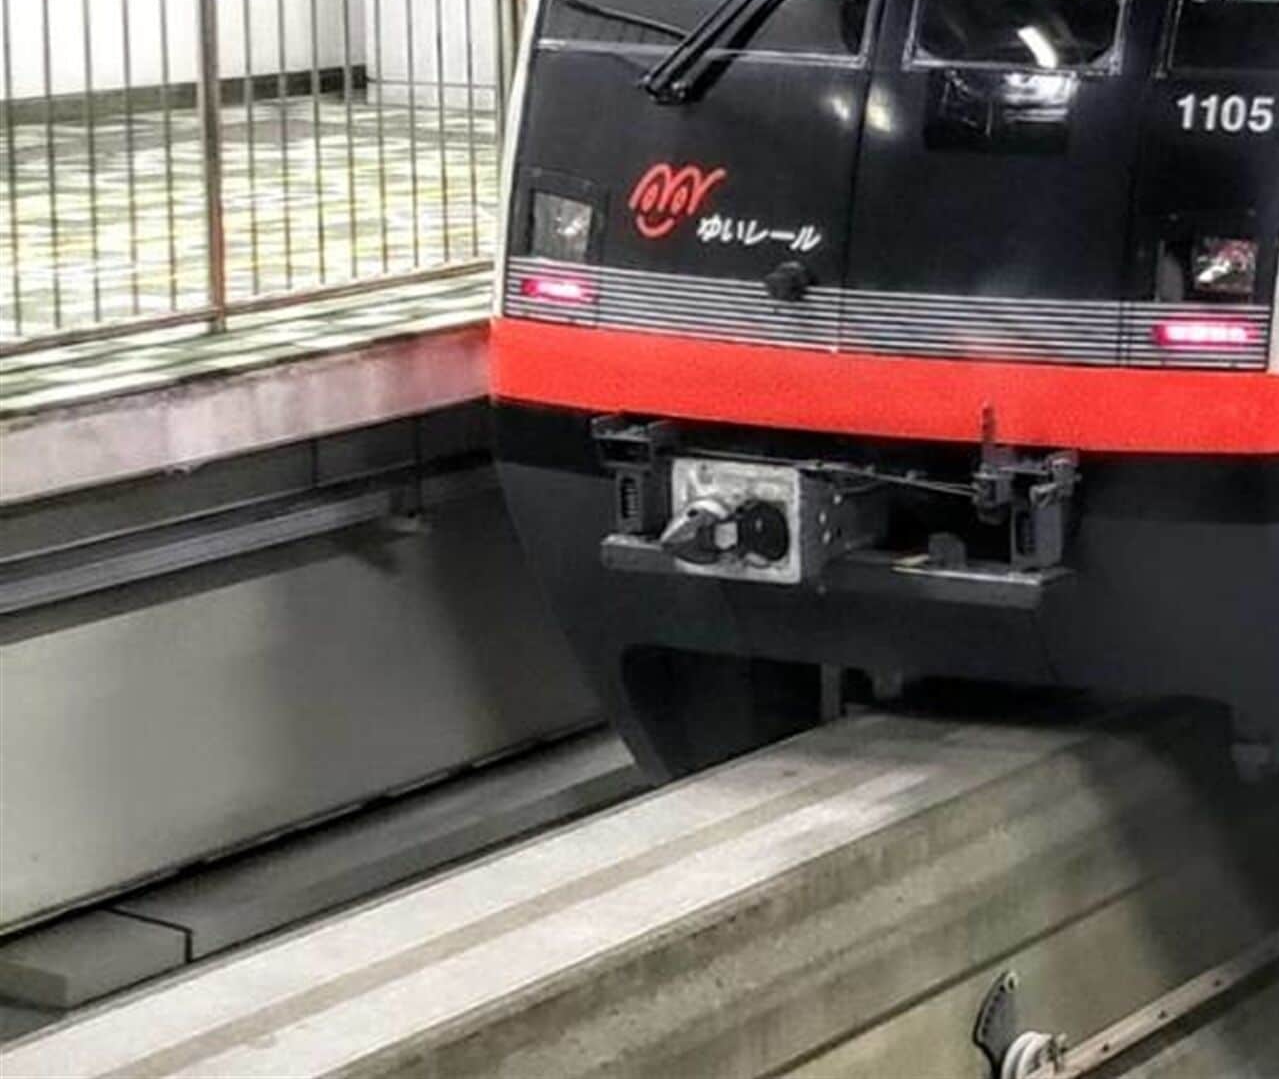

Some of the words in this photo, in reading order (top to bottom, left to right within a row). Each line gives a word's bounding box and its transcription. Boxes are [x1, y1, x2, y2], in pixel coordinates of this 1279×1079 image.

[1176, 93, 1275, 133] 1105
[697, 213, 822, 252] ゆいレール
